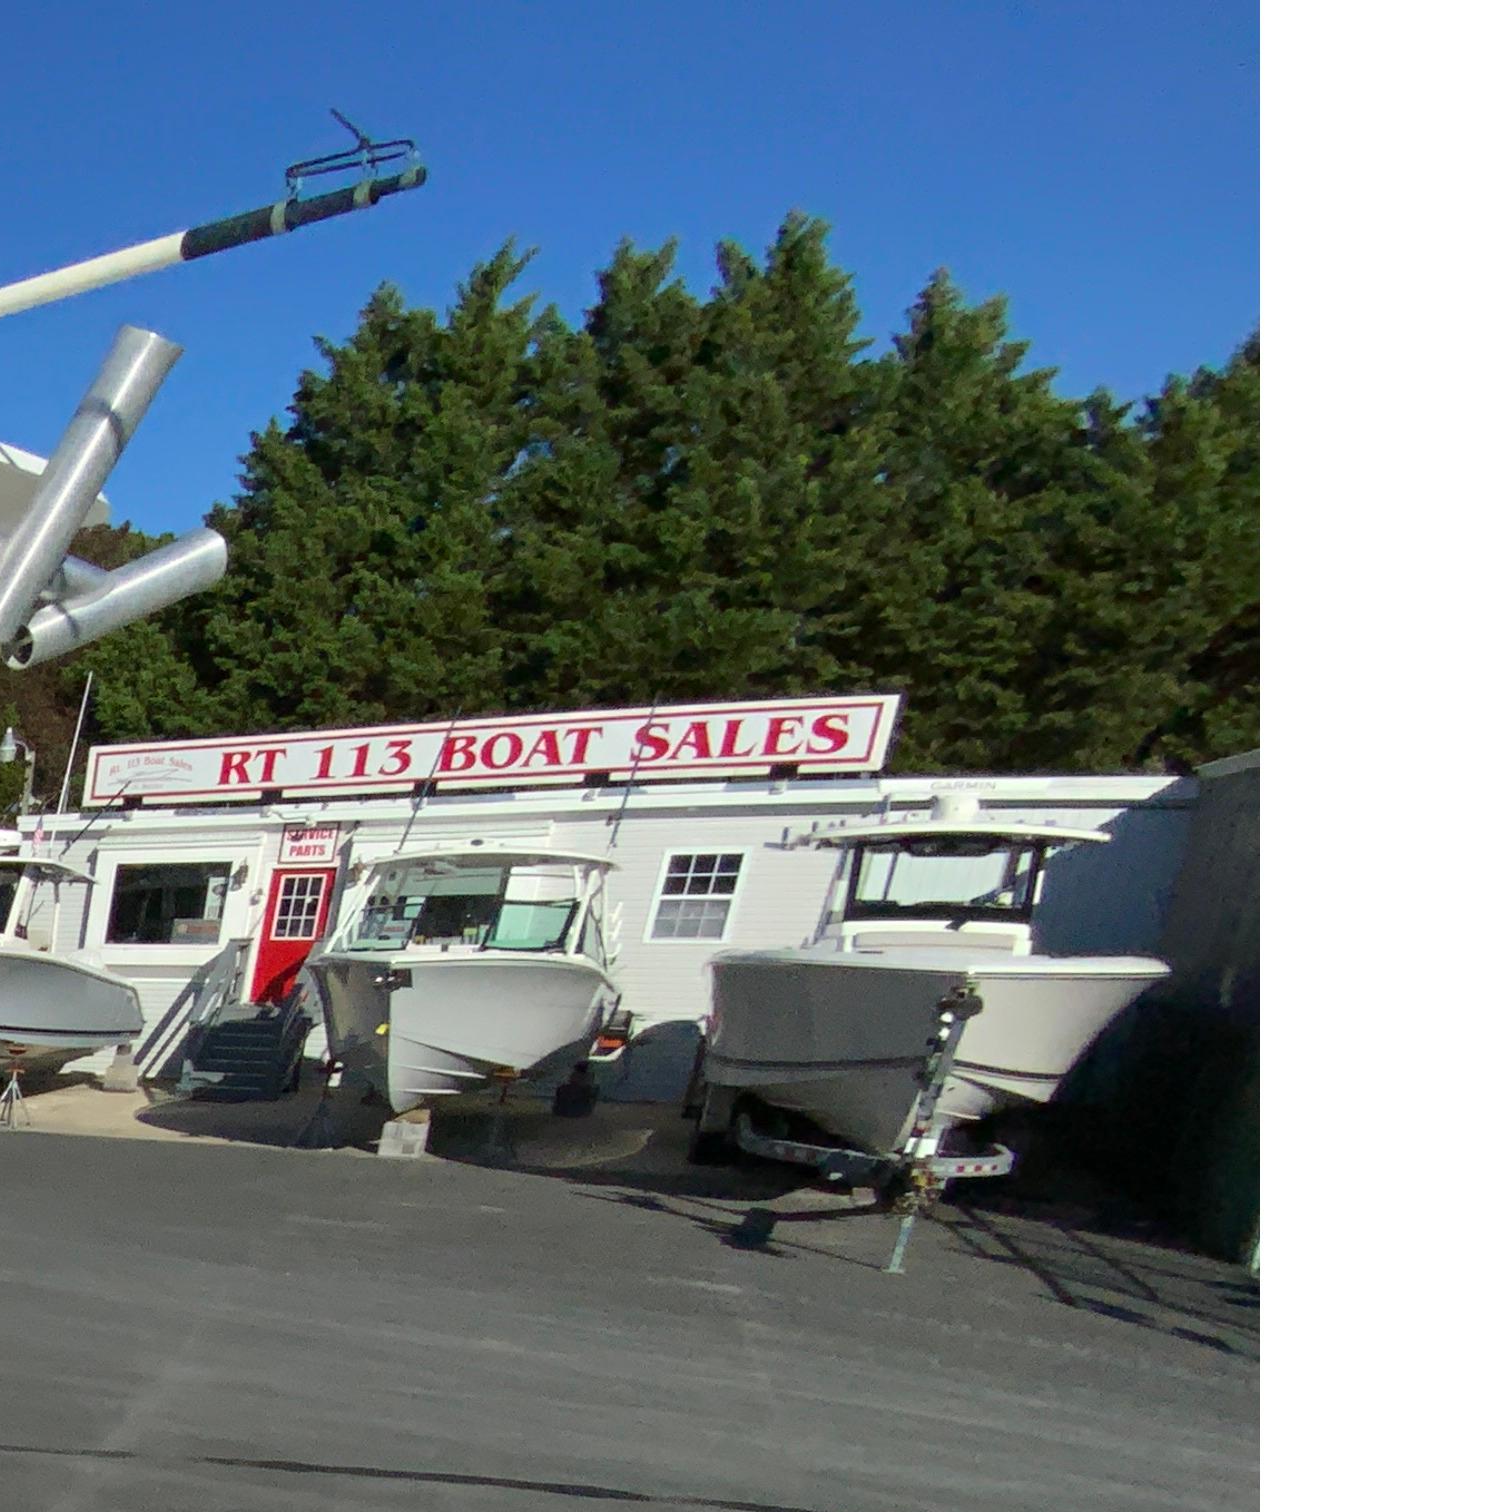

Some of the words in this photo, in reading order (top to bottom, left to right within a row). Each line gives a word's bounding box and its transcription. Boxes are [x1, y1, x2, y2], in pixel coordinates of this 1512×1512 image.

[217, 748, 287, 786] RT
[309, 739, 413, 781] 113
[437, 726, 603, 773] BOAT
[629, 713, 850, 763] SALES
[287, 827, 334, 840] SRVICE
[289, 844, 326, 857] PARTS
